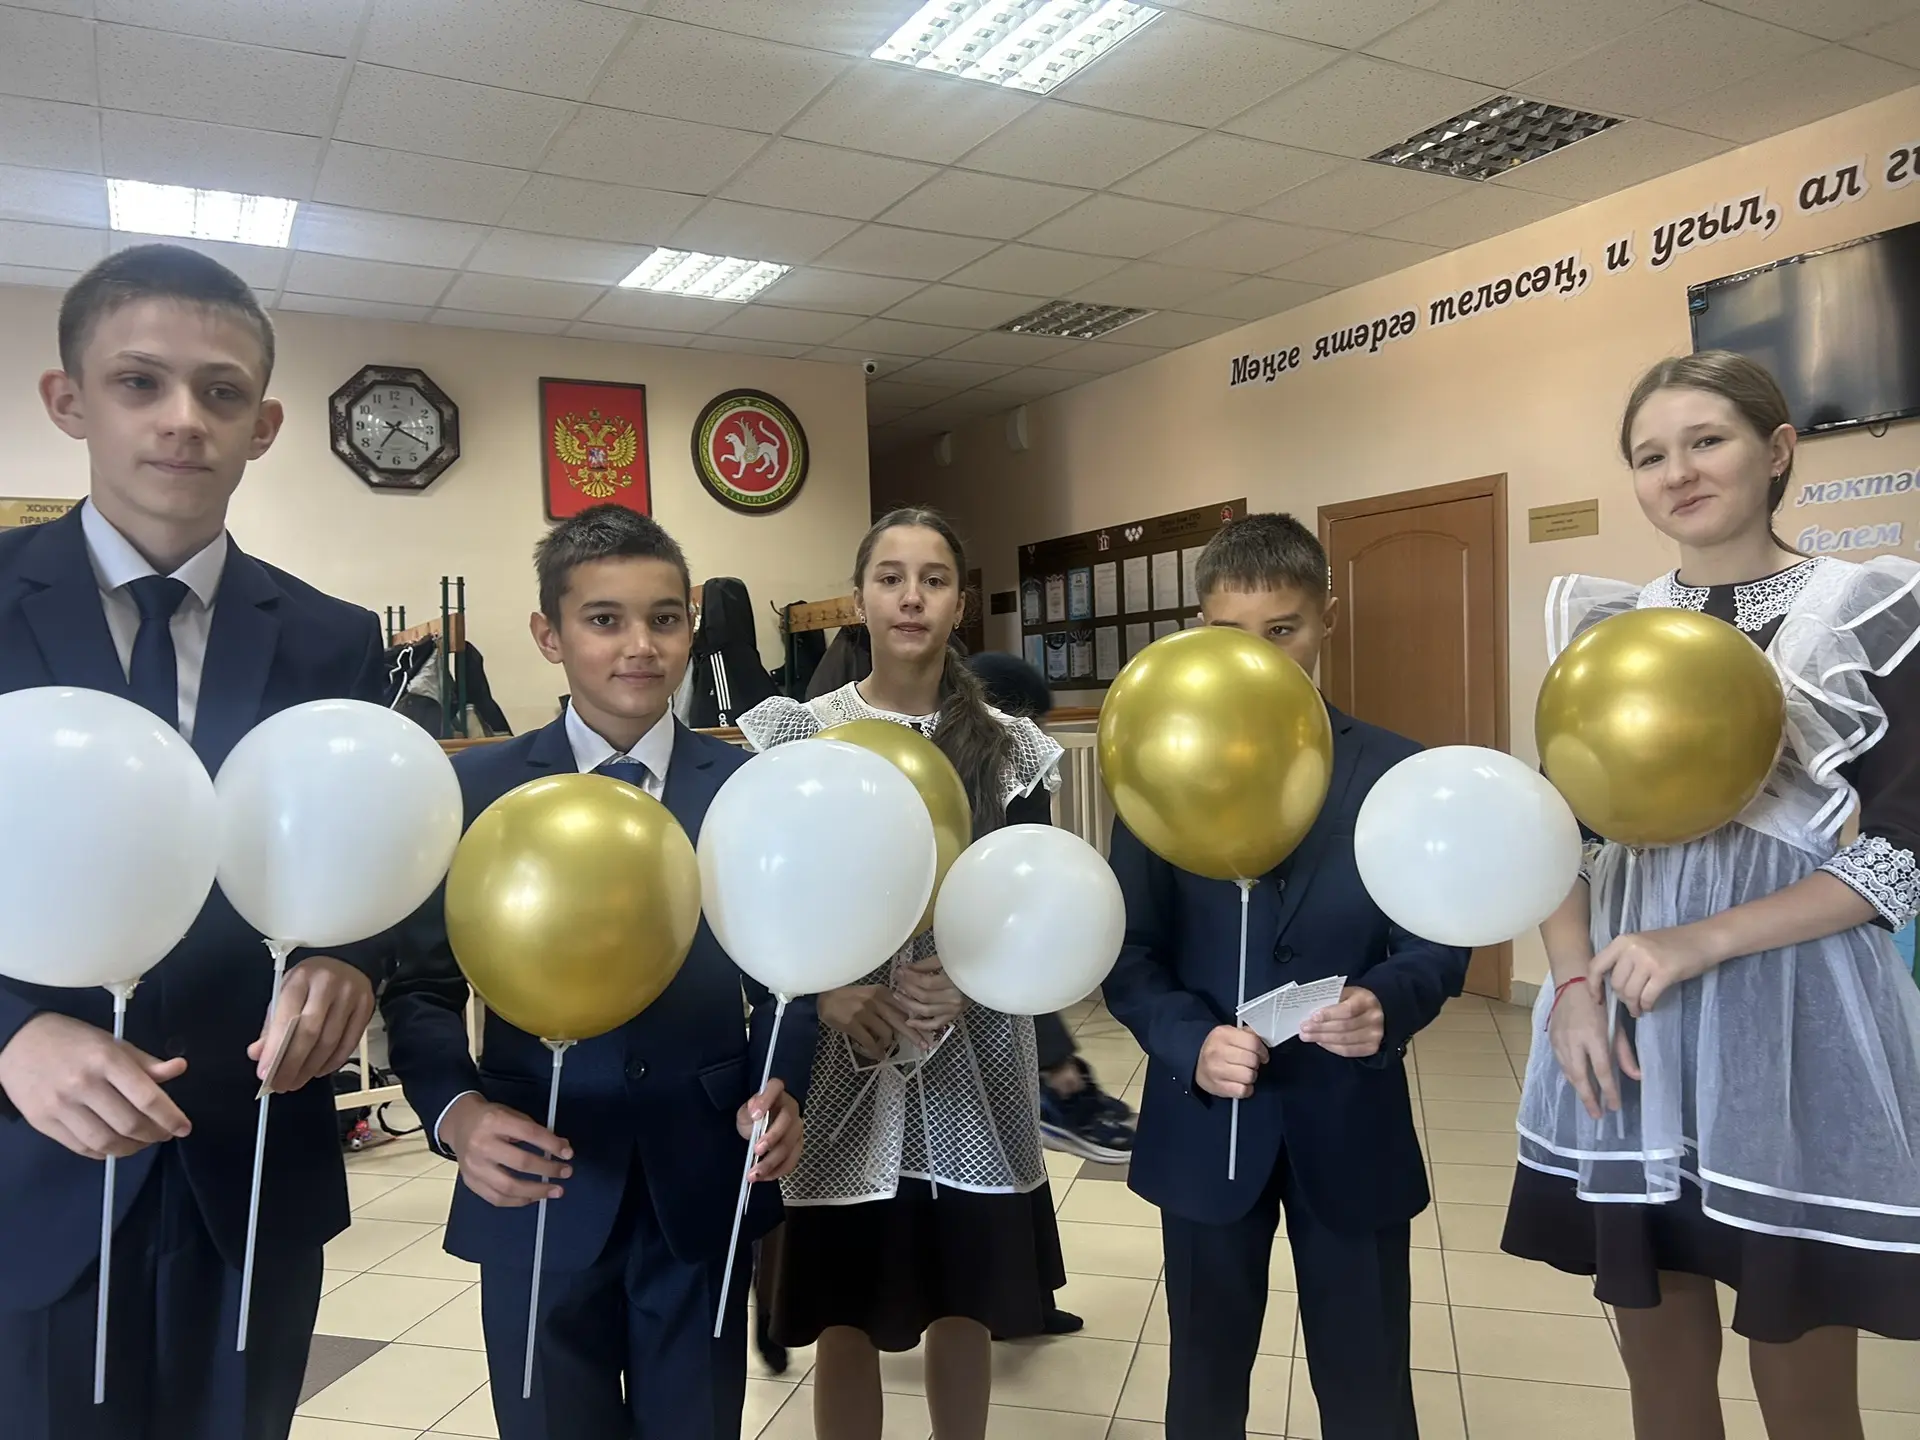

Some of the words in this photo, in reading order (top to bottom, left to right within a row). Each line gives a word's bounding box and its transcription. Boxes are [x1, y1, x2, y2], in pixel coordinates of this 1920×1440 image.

[1230, 346, 1301, 386] Мәңге
[1312, 310, 1417, 360] яшәргә
[1429, 256, 1588, 325] теләсәң,
[1606, 239, 1630, 270] и
[1651, 195, 1777, 266] угыл,
[1799, 164, 1862, 209] ал
[373, 394, 382, 404] 11
[389, 390, 401, 401] 12
[359, 405, 370, 415] 10
[420, 409, 429, 419] 2
[355, 421, 365, 431] 9
[425, 425, 434, 435] 3
[361, 437, 370, 448] 8
[374, 450, 383, 461] 7
[392, 456, 401, 466] 6
[409, 452, 418, 463] 5
[730, 489, 781, 503] ТАТАРСТАН
[1798, 524, 1901, 553] белем
